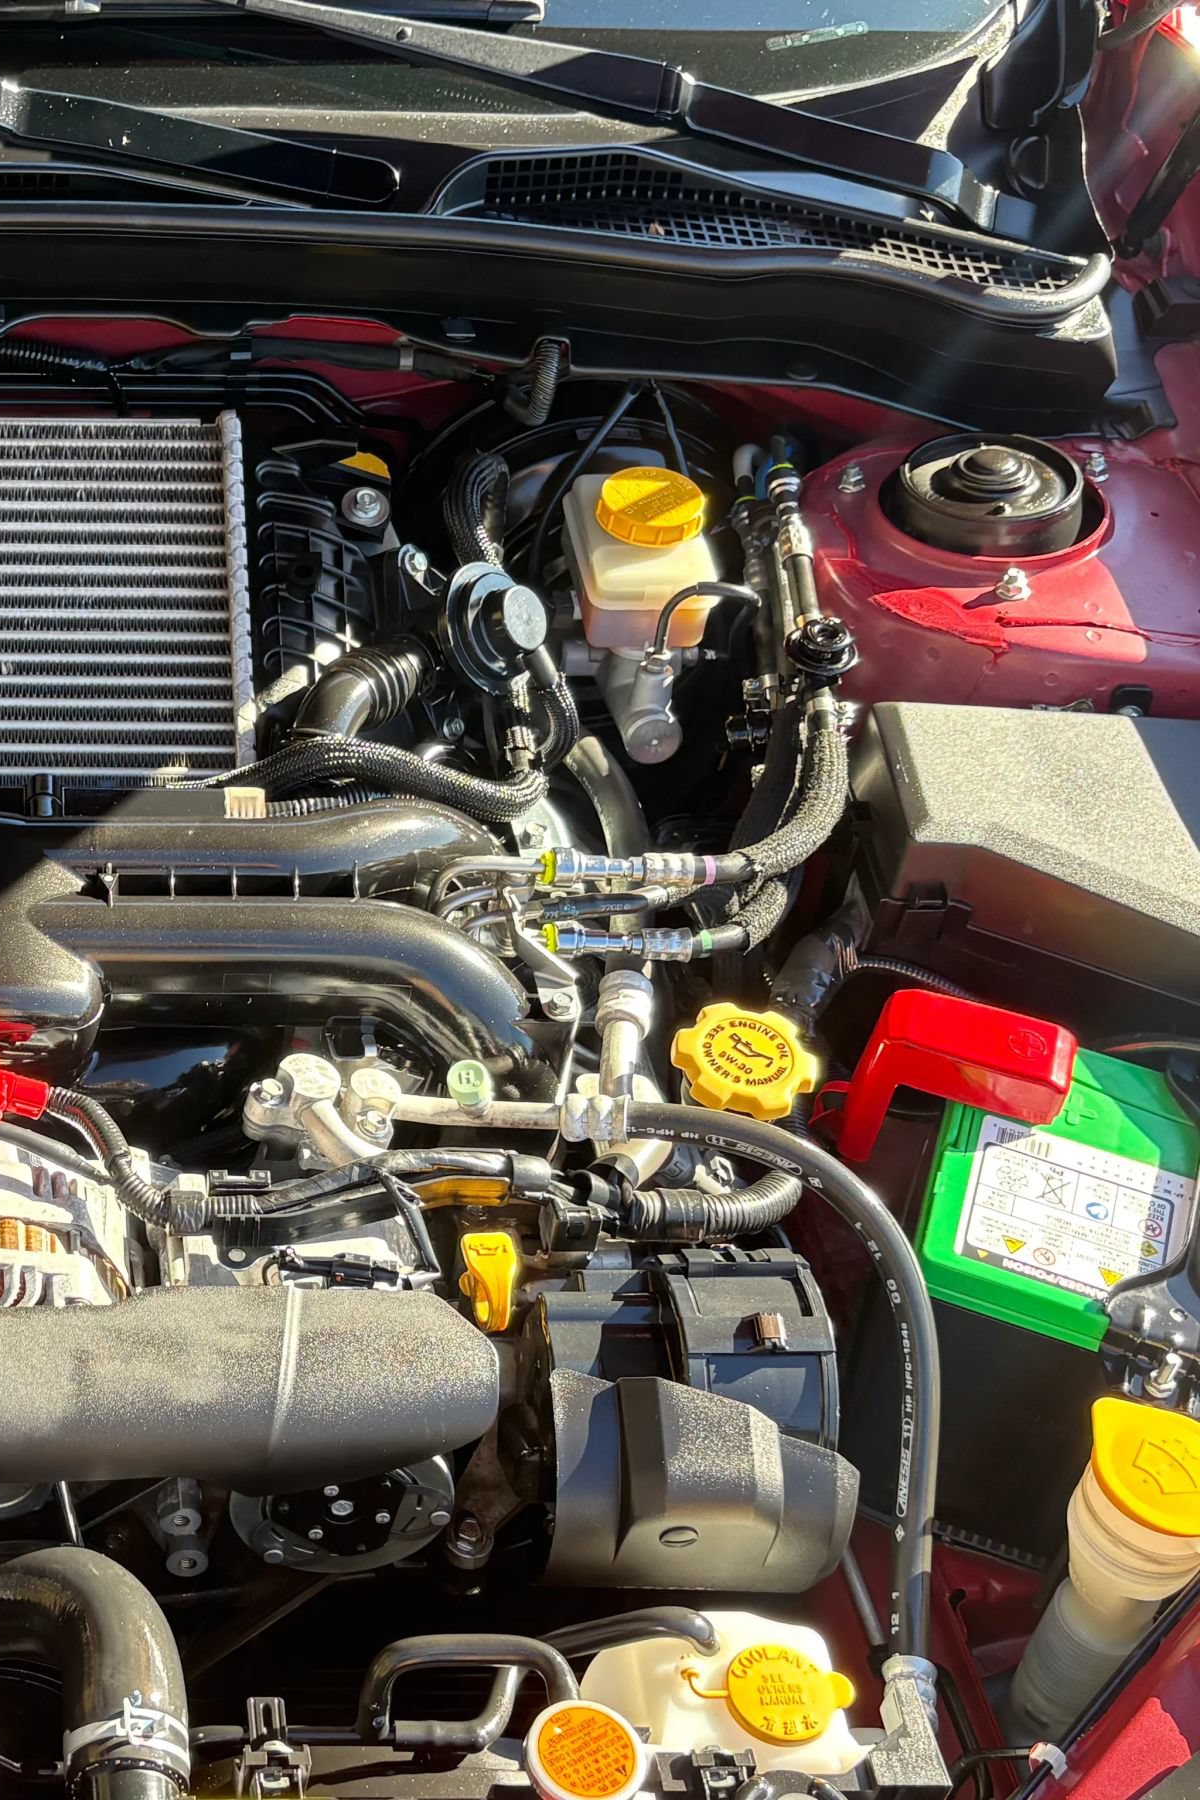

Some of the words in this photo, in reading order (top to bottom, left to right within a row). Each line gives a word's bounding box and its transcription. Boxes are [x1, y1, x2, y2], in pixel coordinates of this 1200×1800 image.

[704, 1023, 725, 1041] SEE
[729, 1020, 779, 1042] ENGINE
[776, 1042, 790, 1060] OIL
[702, 1041, 741, 1084] OWNER'S
[745, 1066, 788, 1087] MANUAL
[1003, 1257, 1110, 1305] ANGER/POISON
[891, 1612, 900, 1635] 12
[761, 1673, 785, 1684] SEE
[759, 1695, 807, 1706] MANUAL
